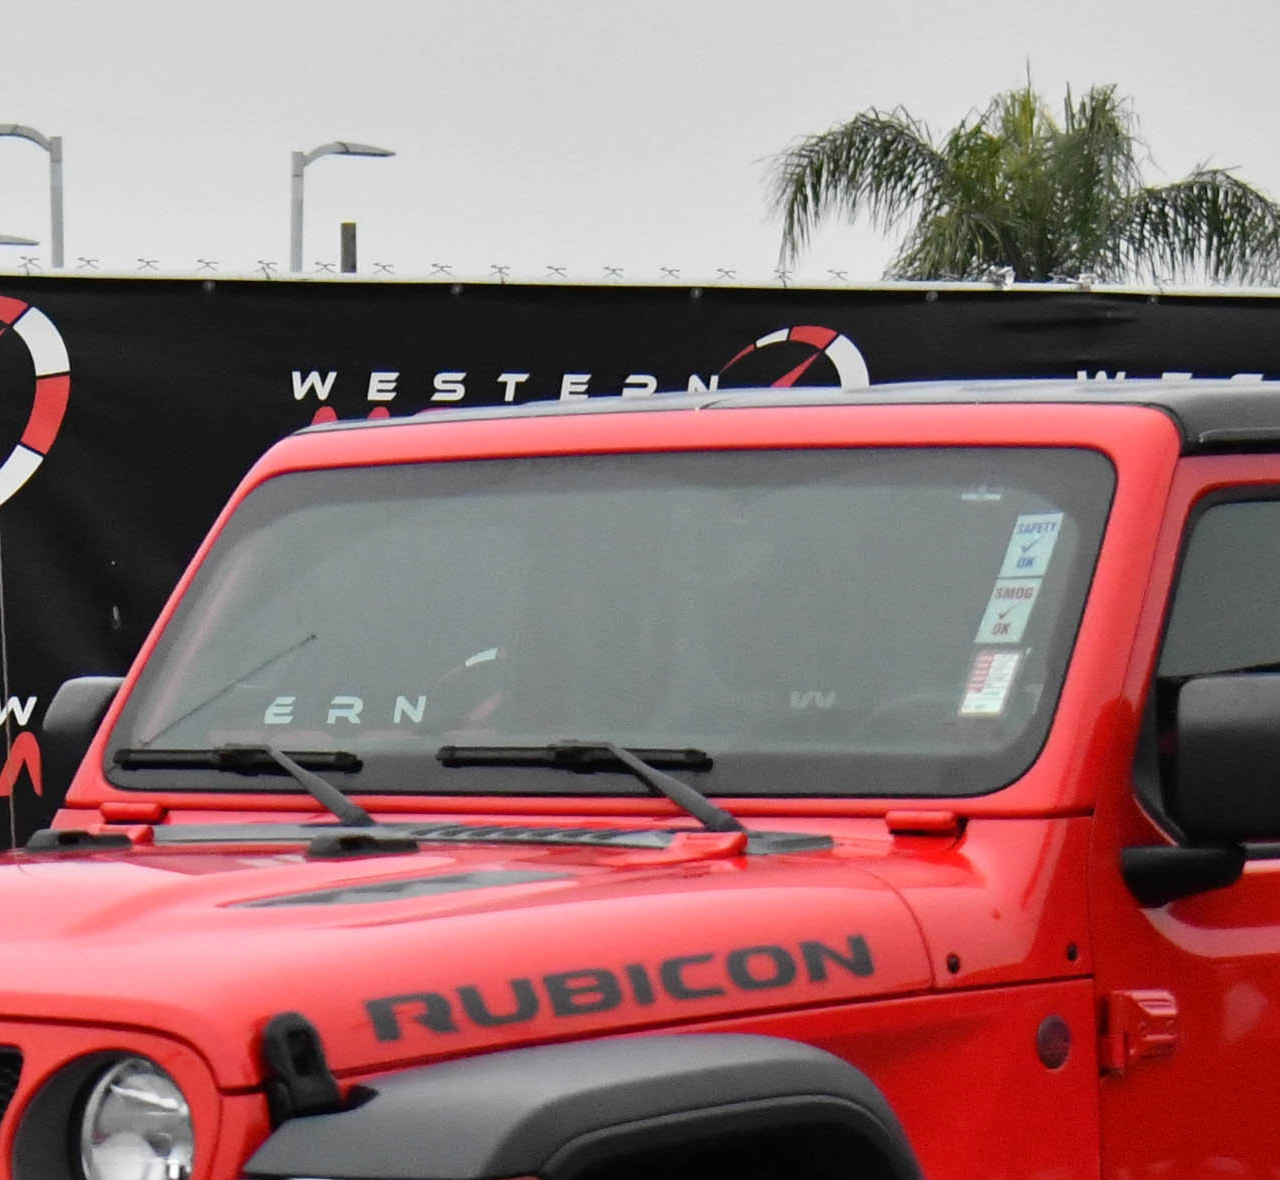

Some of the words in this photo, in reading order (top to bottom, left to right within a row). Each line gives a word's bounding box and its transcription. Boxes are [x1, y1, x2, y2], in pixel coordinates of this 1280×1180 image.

[1017, 522, 1058, 535] SAFETY
[1016, 556, 1035, 569] OK
[994, 586, 1034, 600] SMOG
[992, 623, 1011, 636] OK
[365, 934, 875, 1042] RUBICON
